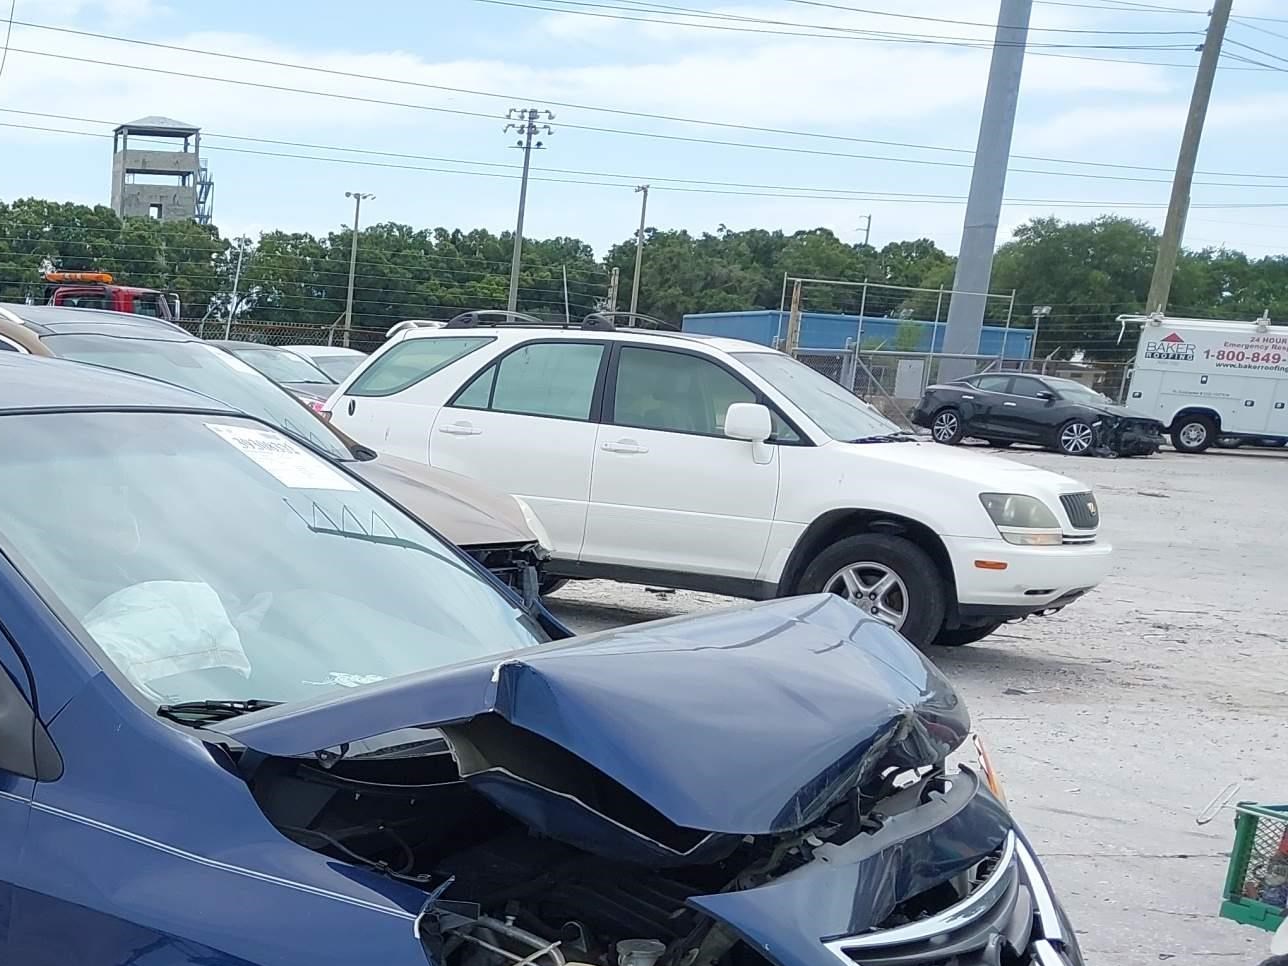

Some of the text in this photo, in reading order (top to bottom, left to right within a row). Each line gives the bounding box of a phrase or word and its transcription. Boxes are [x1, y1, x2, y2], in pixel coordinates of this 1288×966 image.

[1146, 341, 1196, 354] BAKER
[1224, 341, 1269, 350] Emergency
[1145, 352, 1193, 361] ROOFING
[1203, 349, 1287, 364] 1-800-849-
